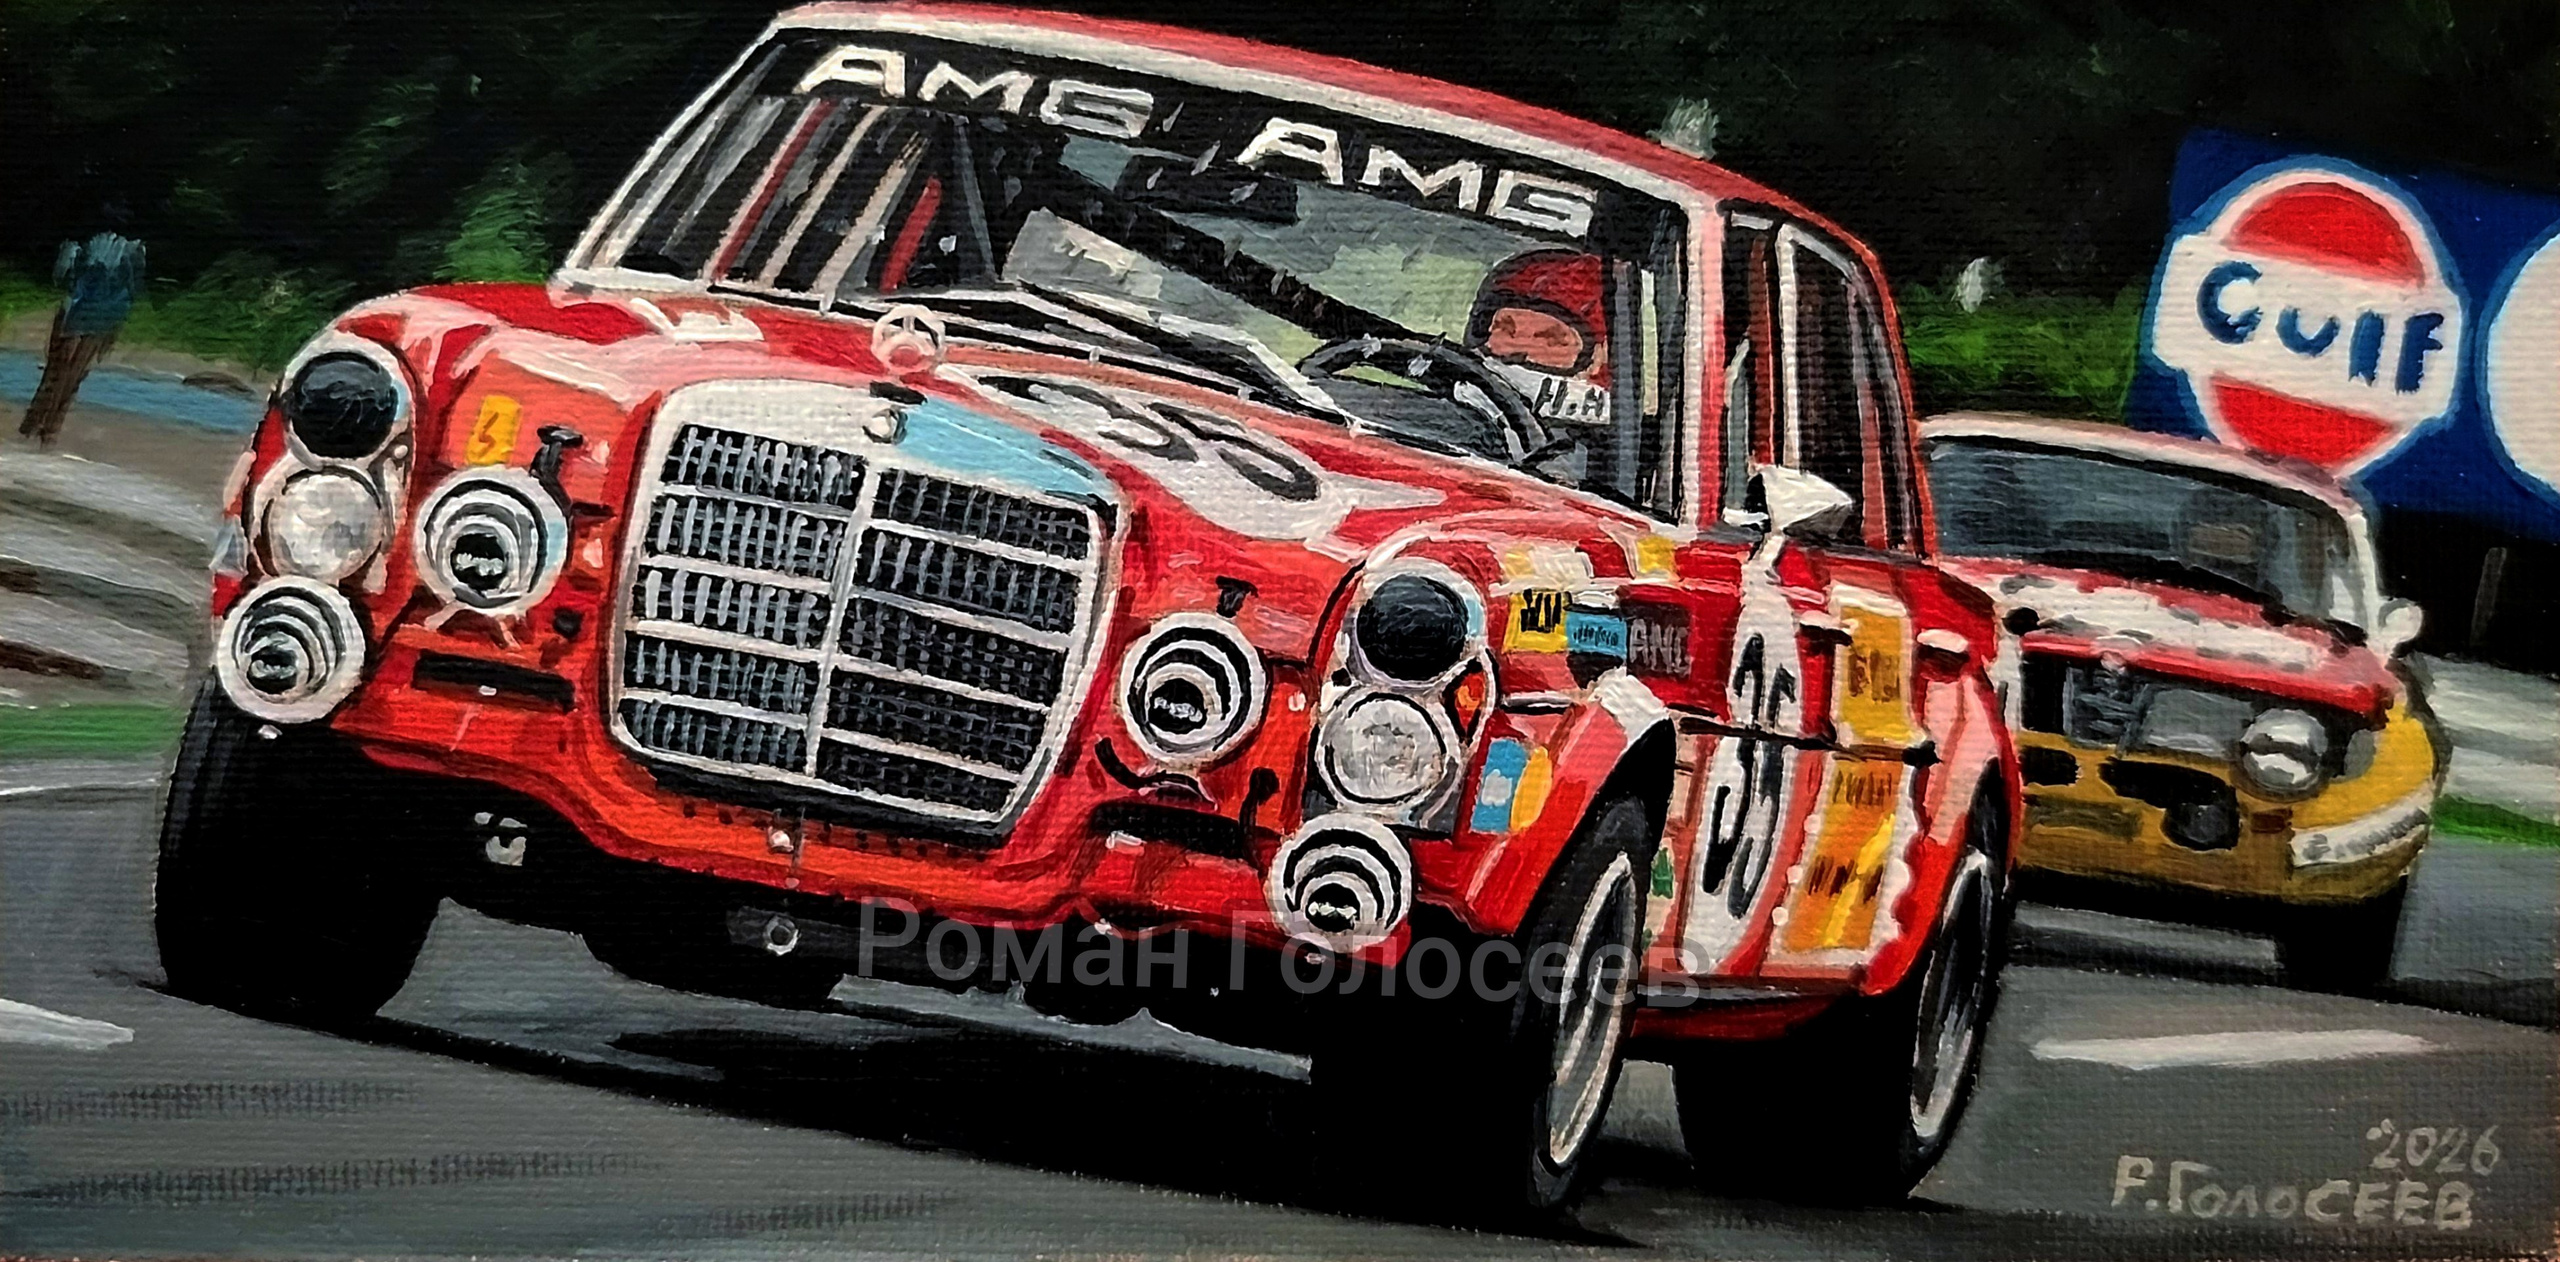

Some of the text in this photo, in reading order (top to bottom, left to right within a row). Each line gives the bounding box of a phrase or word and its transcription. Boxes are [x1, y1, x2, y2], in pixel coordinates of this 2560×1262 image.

[793, 45, 1597, 238] AMG AMG
[2366, 1118, 2499, 1176] 2026
